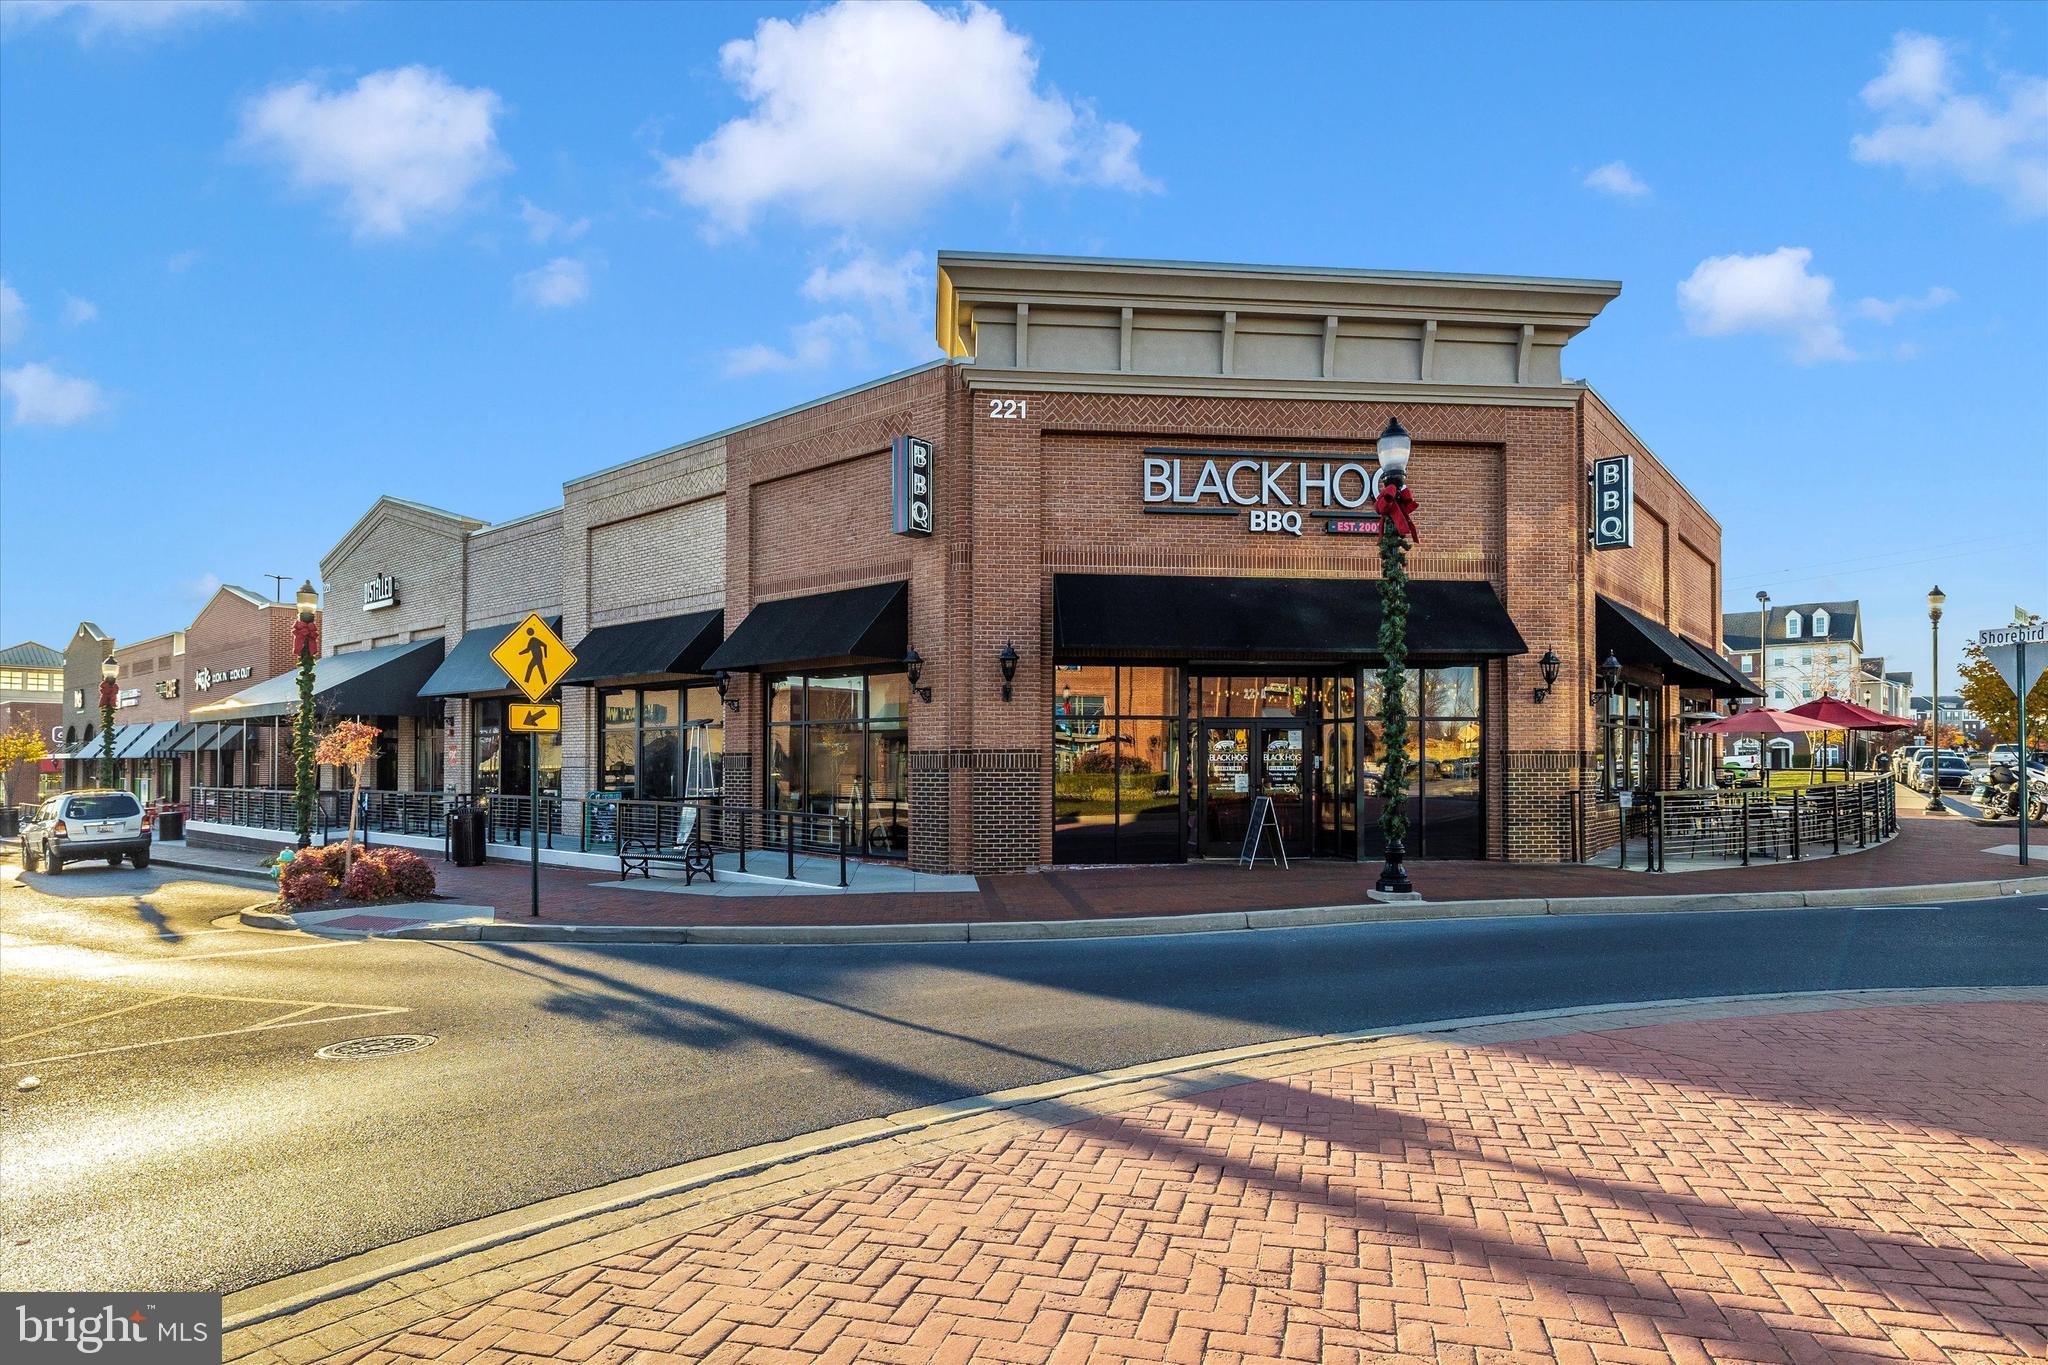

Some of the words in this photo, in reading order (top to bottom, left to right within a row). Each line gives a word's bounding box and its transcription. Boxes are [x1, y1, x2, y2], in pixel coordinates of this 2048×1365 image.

[989, 399, 1026, 419] 221
[913, 445, 928, 528] BBQ
[1602, 464, 1622, 540] BBQ
[1250, 510, 1302, 535] BBQ
[1337, 521, 1357, 531] EST.
[1359, 522, 1380, 532] 200
[1981, 627, 2044, 644] Shorebird
